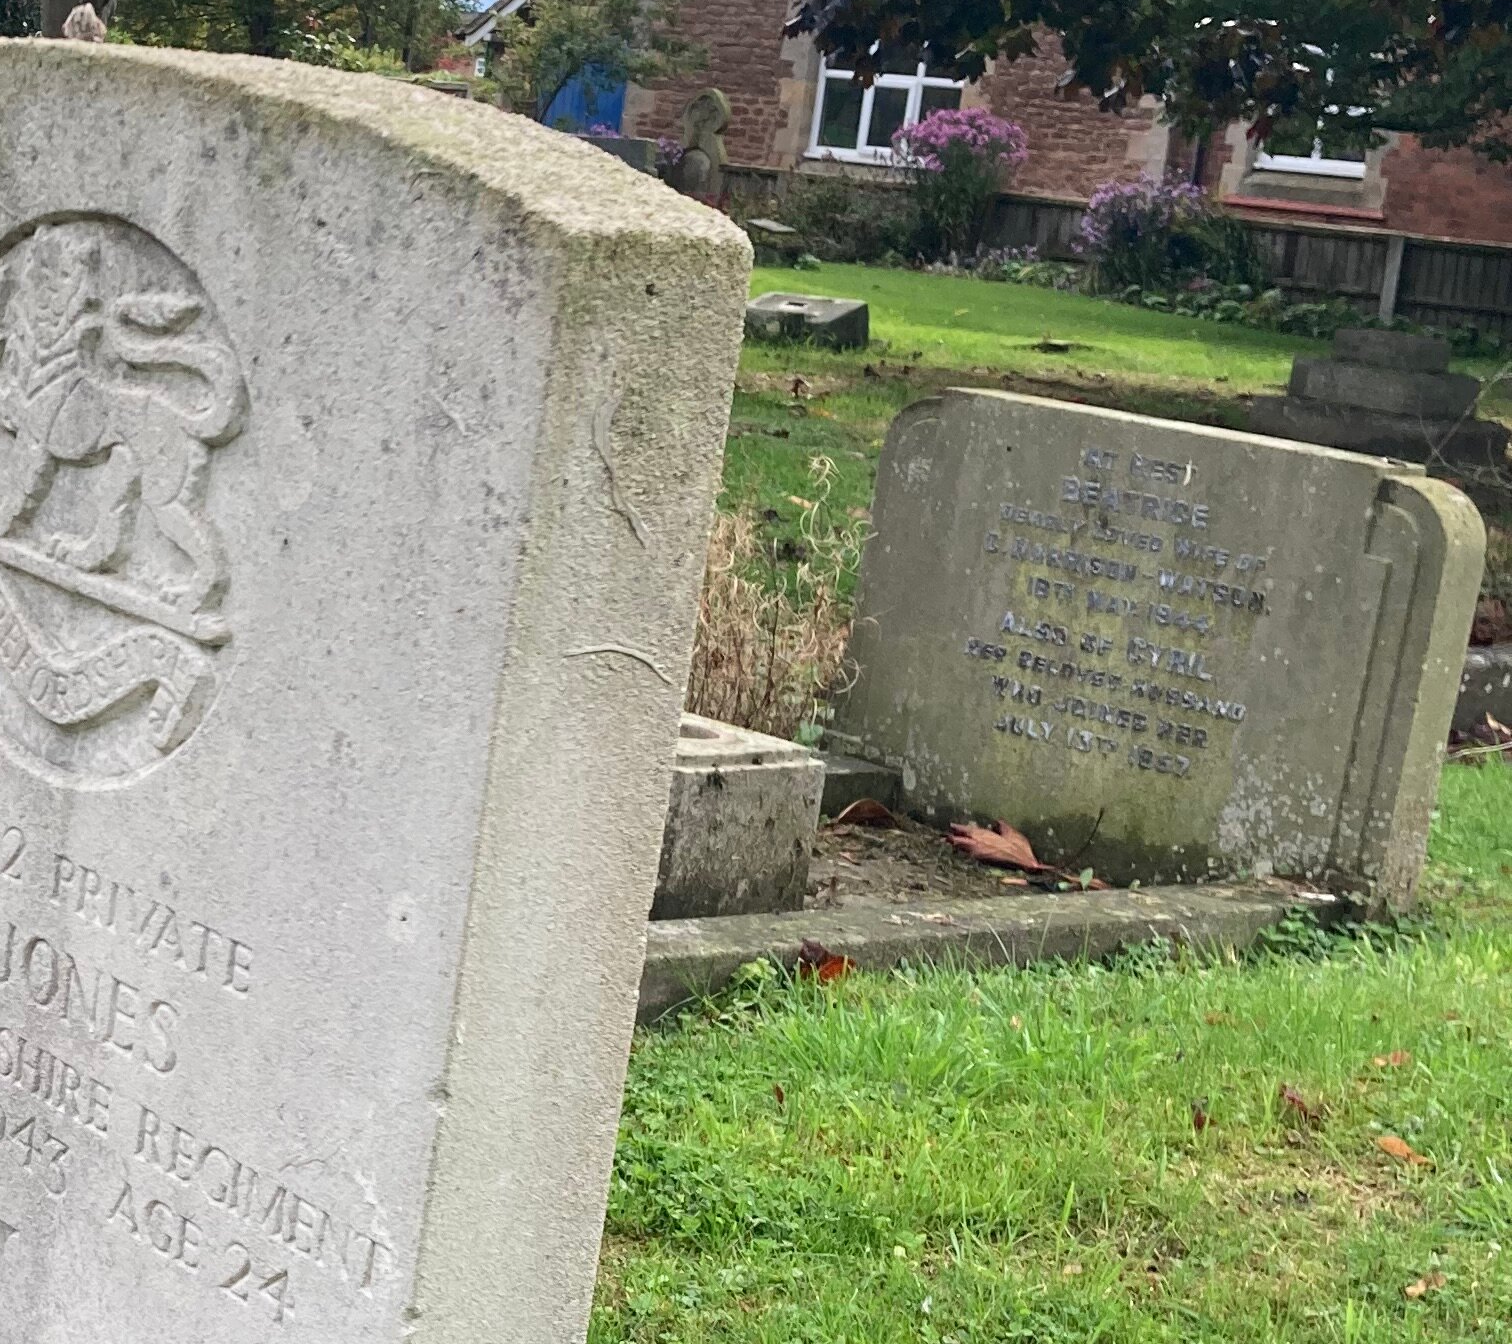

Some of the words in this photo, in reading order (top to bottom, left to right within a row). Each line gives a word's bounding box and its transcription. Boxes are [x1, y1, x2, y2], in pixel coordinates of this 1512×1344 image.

[1061, 474, 1211, 530] BEATRICE
[1173, 537, 1231, 568] WIFE
[1000, 610, 1069, 648] ALSO
[1079, 631, 1115, 657] OF
[1126, 636, 1214, 683] CYRIL
[991, 674, 1043, 706] WHO
[1052, 694, 1149, 734] JOINED
[1156, 718, 1209, 750] HER
[1017, 649, 1123, 691] BELOVED
[1129, 678, 1248, 724] HUSBAND
[992, 714, 1056, 746] JULY
[50, 852, 255, 996] PRIVATE
[133, 1105, 393, 1293] REGIMENT
[105, 1178, 205, 1270] AGE
[216, 1240, 296, 1323] 24
